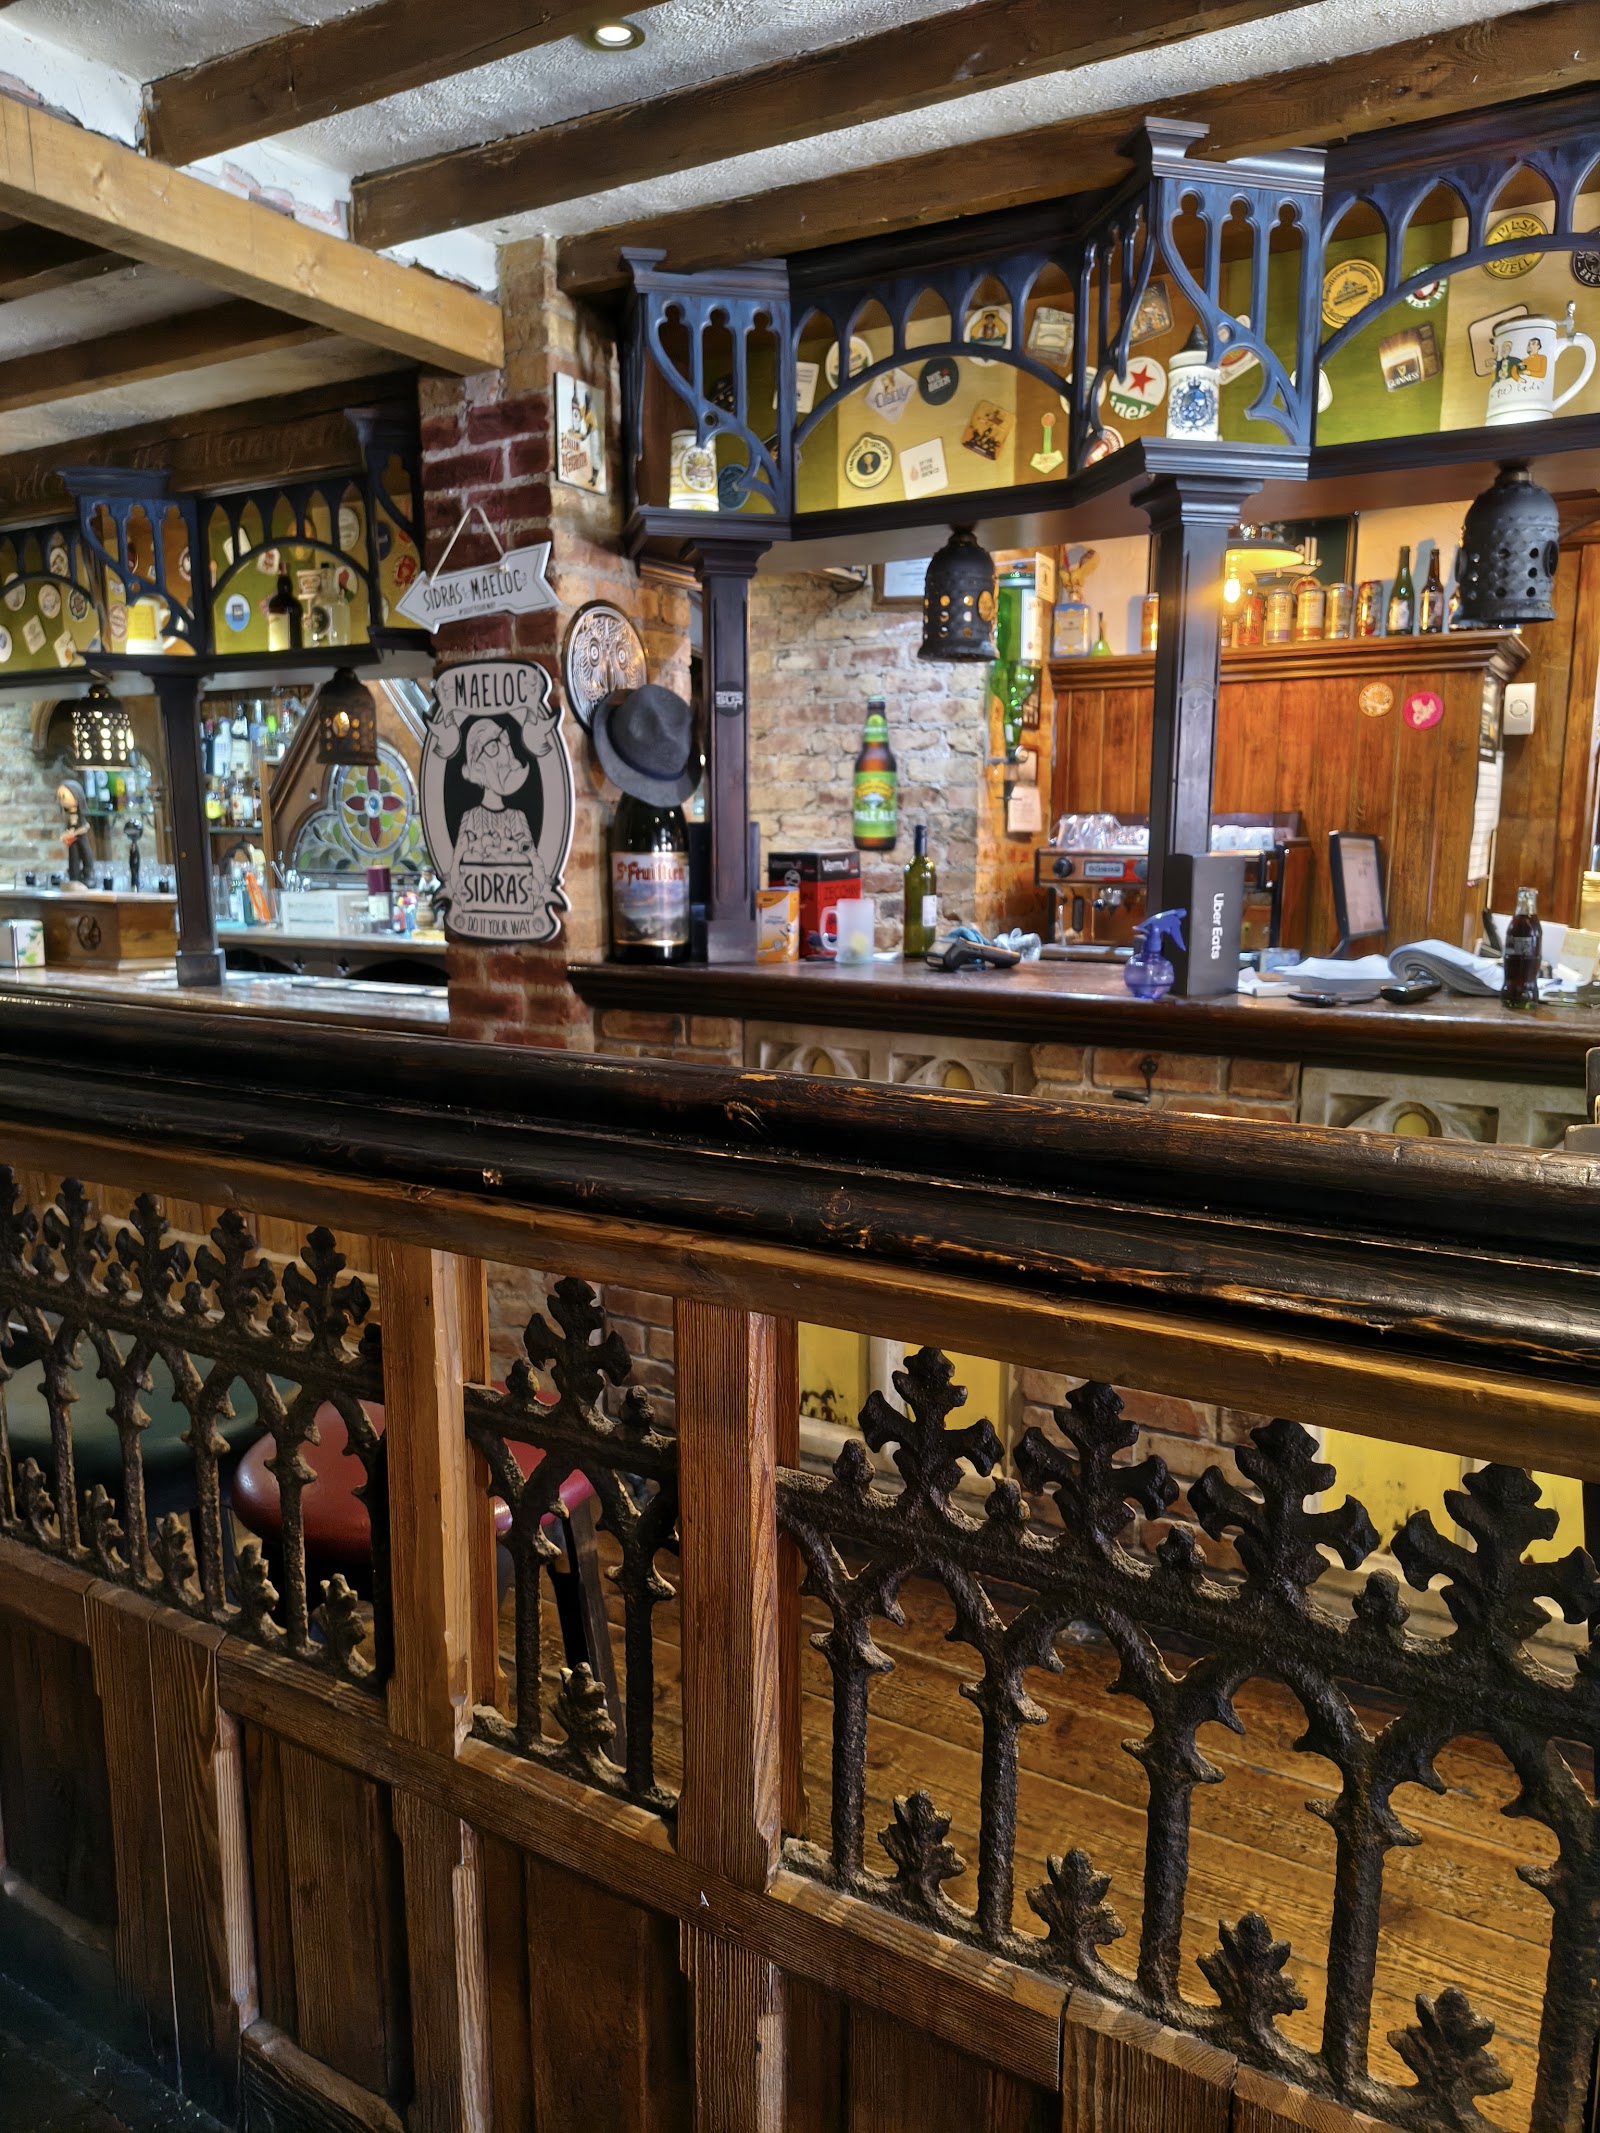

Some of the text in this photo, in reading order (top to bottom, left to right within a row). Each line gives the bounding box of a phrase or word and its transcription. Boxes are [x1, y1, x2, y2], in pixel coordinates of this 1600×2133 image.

[1496, 219, 1539, 238] PILSN
[1492, 258, 1533, 273] QUELL
[1579, 268, 1600, 283] BRE
[1387, 372, 1420, 389] GUINNESS
[423, 569, 523, 612] SIDRAS MAELOC
[454, 669, 528, 709] MAELOC
[464, 872, 529, 905] SIDRAS
[467, 915, 479, 932] DO
[488, 918, 509, 935] YOUR
[510, 917, 532, 936] WAY
[1210, 892, 1225, 960] Uber Eats
